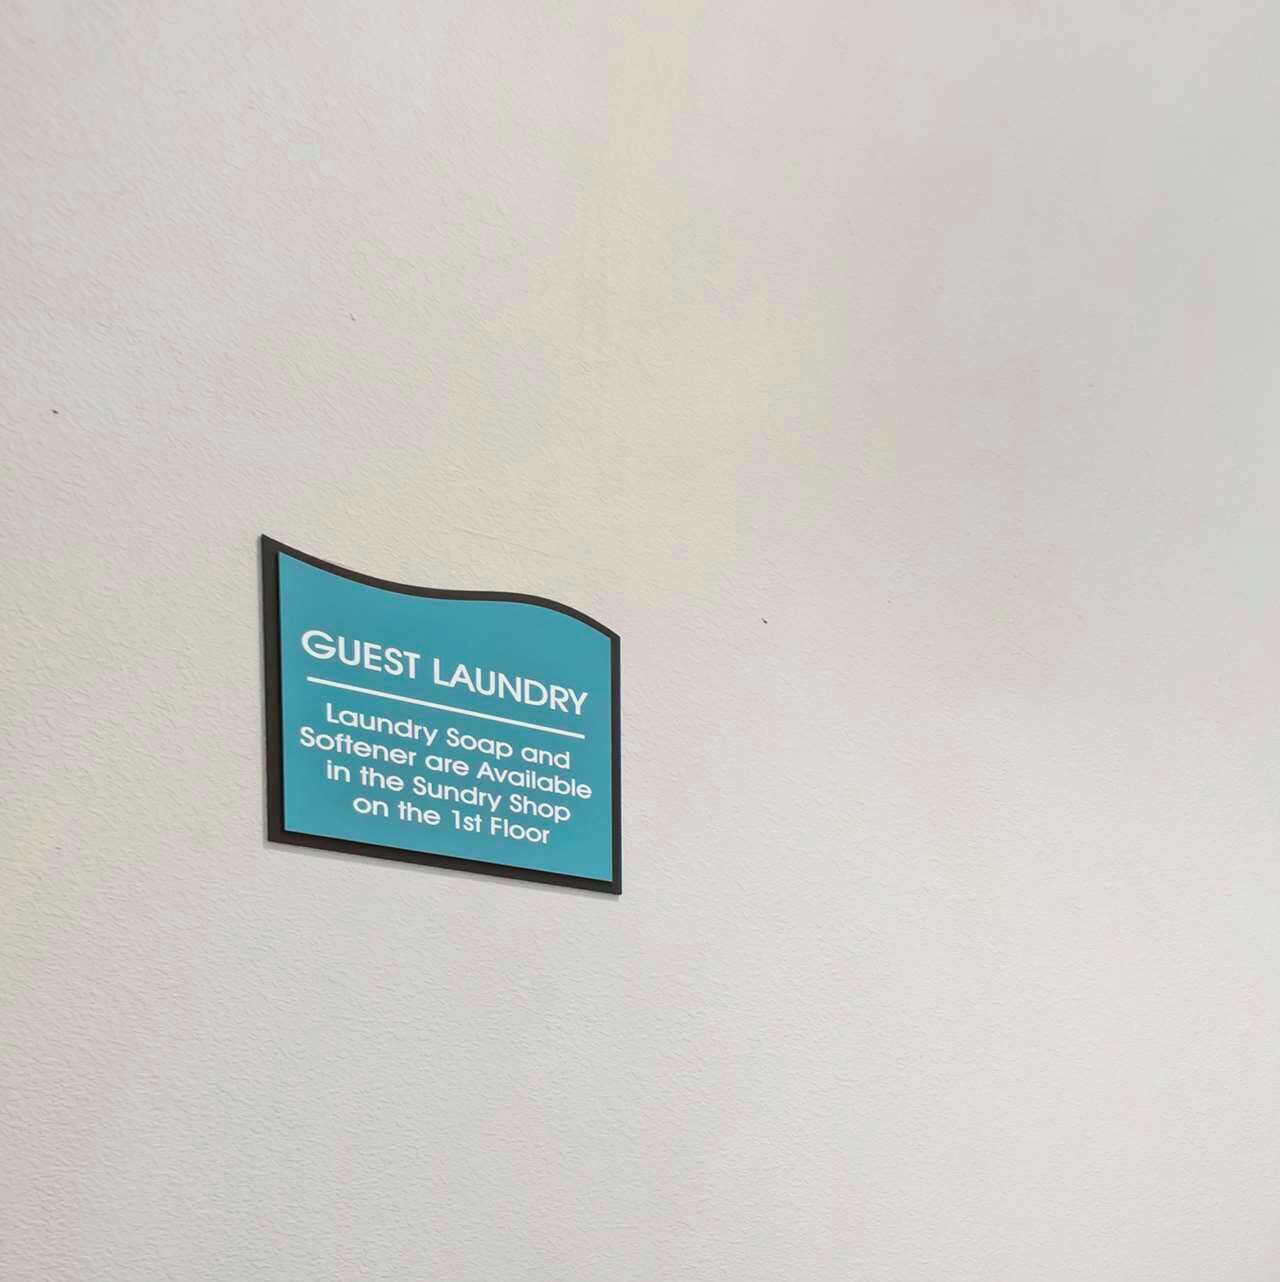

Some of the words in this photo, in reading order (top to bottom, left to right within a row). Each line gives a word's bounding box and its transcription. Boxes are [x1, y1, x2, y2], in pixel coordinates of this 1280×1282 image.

[301, 630, 421, 680] GUEST
[433, 657, 588, 716] LAUNDRY
[300, 726, 416, 766] Softener
[425, 754, 469, 776] are
[477, 766, 592, 799] Available
[326, 703, 438, 746] Laundry
[446, 728, 513, 759] Soap
[521, 743, 570, 769] and
[326, 760, 350, 782] in
[360, 766, 404, 791] the
[413, 776, 501, 812] Sundry
[508, 795, 571, 823] Shop
[352, 797, 389, 817] on
[397, 803, 440, 825] the
[451, 810, 482, 832] 1st
[490, 817, 550, 844] Floor
